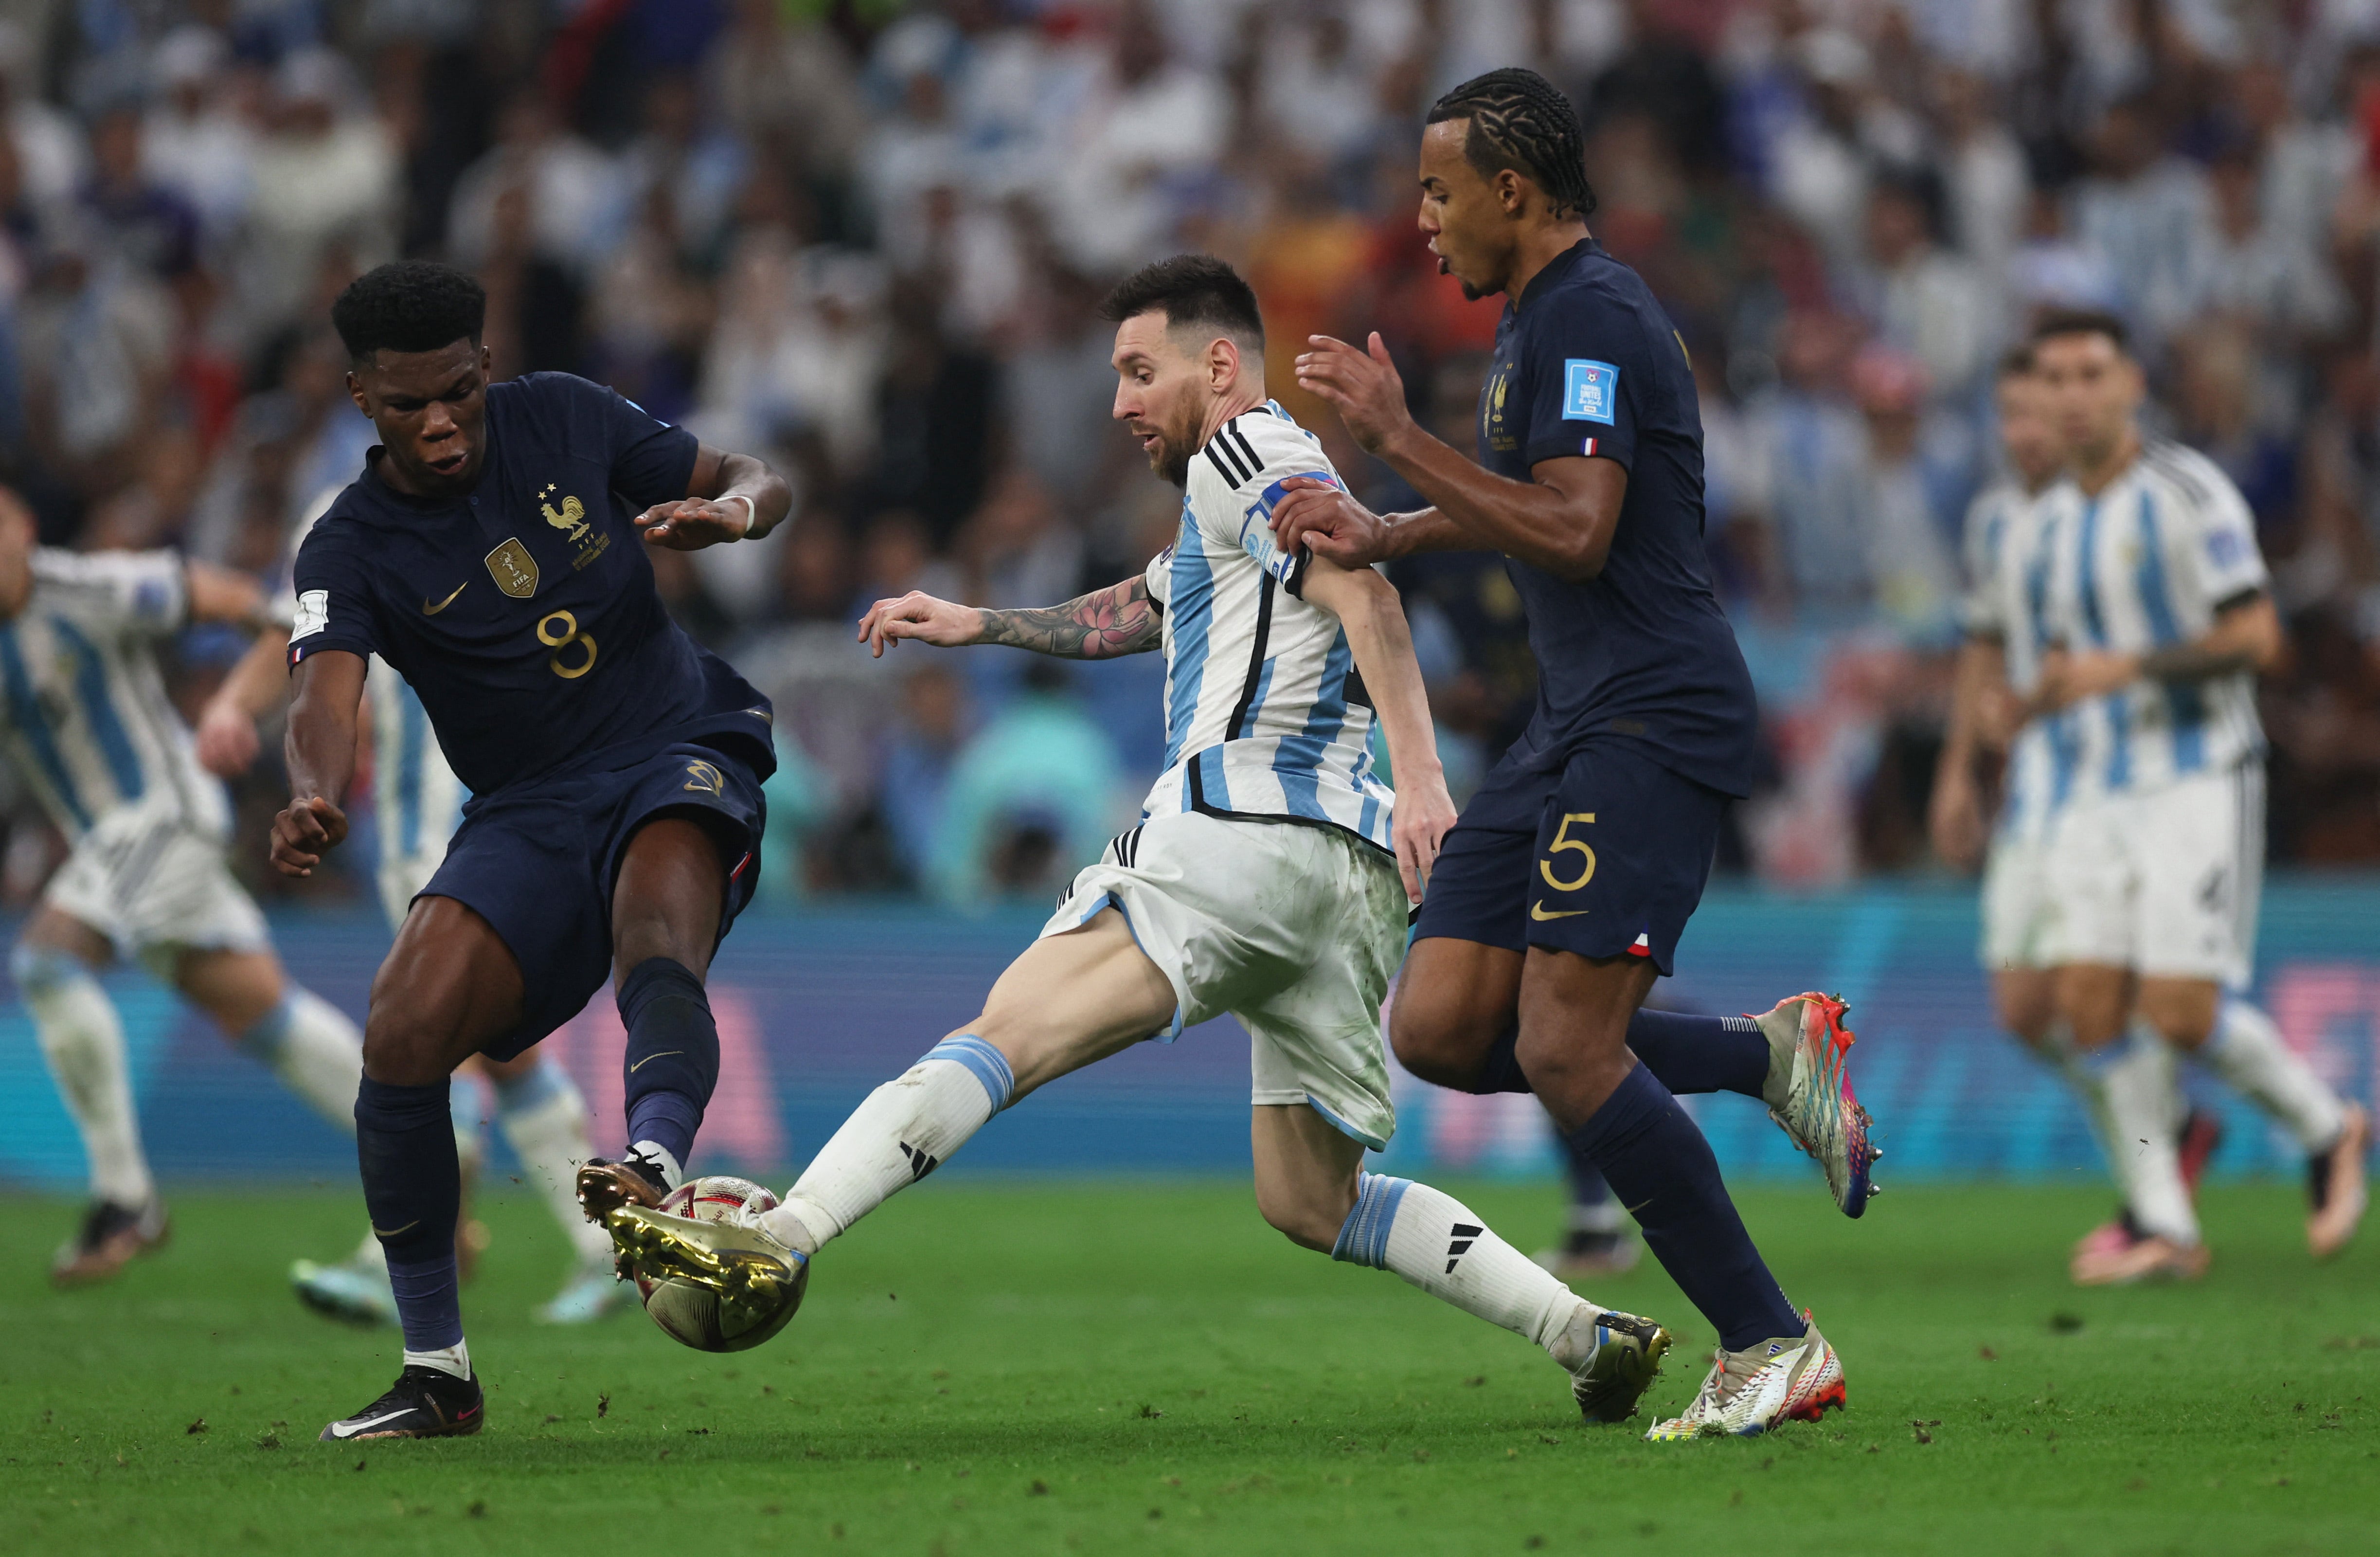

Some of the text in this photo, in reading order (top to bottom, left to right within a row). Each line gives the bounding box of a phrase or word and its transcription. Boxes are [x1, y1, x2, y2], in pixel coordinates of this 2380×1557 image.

[1580, 391, 1601, 399] UNITES
[513, 574, 529, 587] FIFA
[537, 610, 597, 679] 8
[1540, 813, 1595, 891] 5
